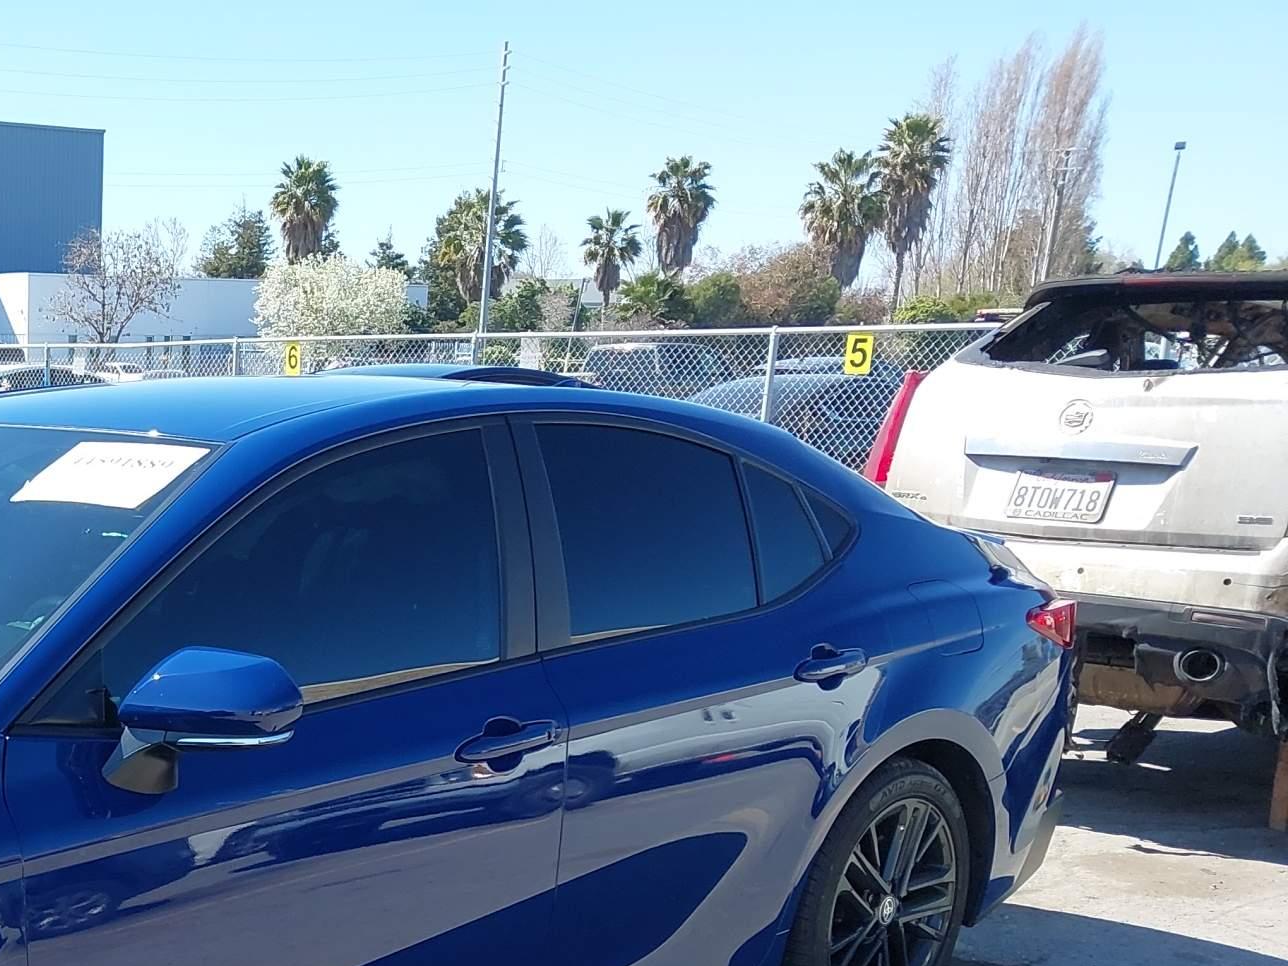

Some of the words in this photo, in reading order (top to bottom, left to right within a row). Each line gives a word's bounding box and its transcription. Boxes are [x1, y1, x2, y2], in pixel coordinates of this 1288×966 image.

[288, 345, 298, 369] 6
[850, 338, 868, 368] 5
[1025, 510, 1089, 520] CADILLAC
